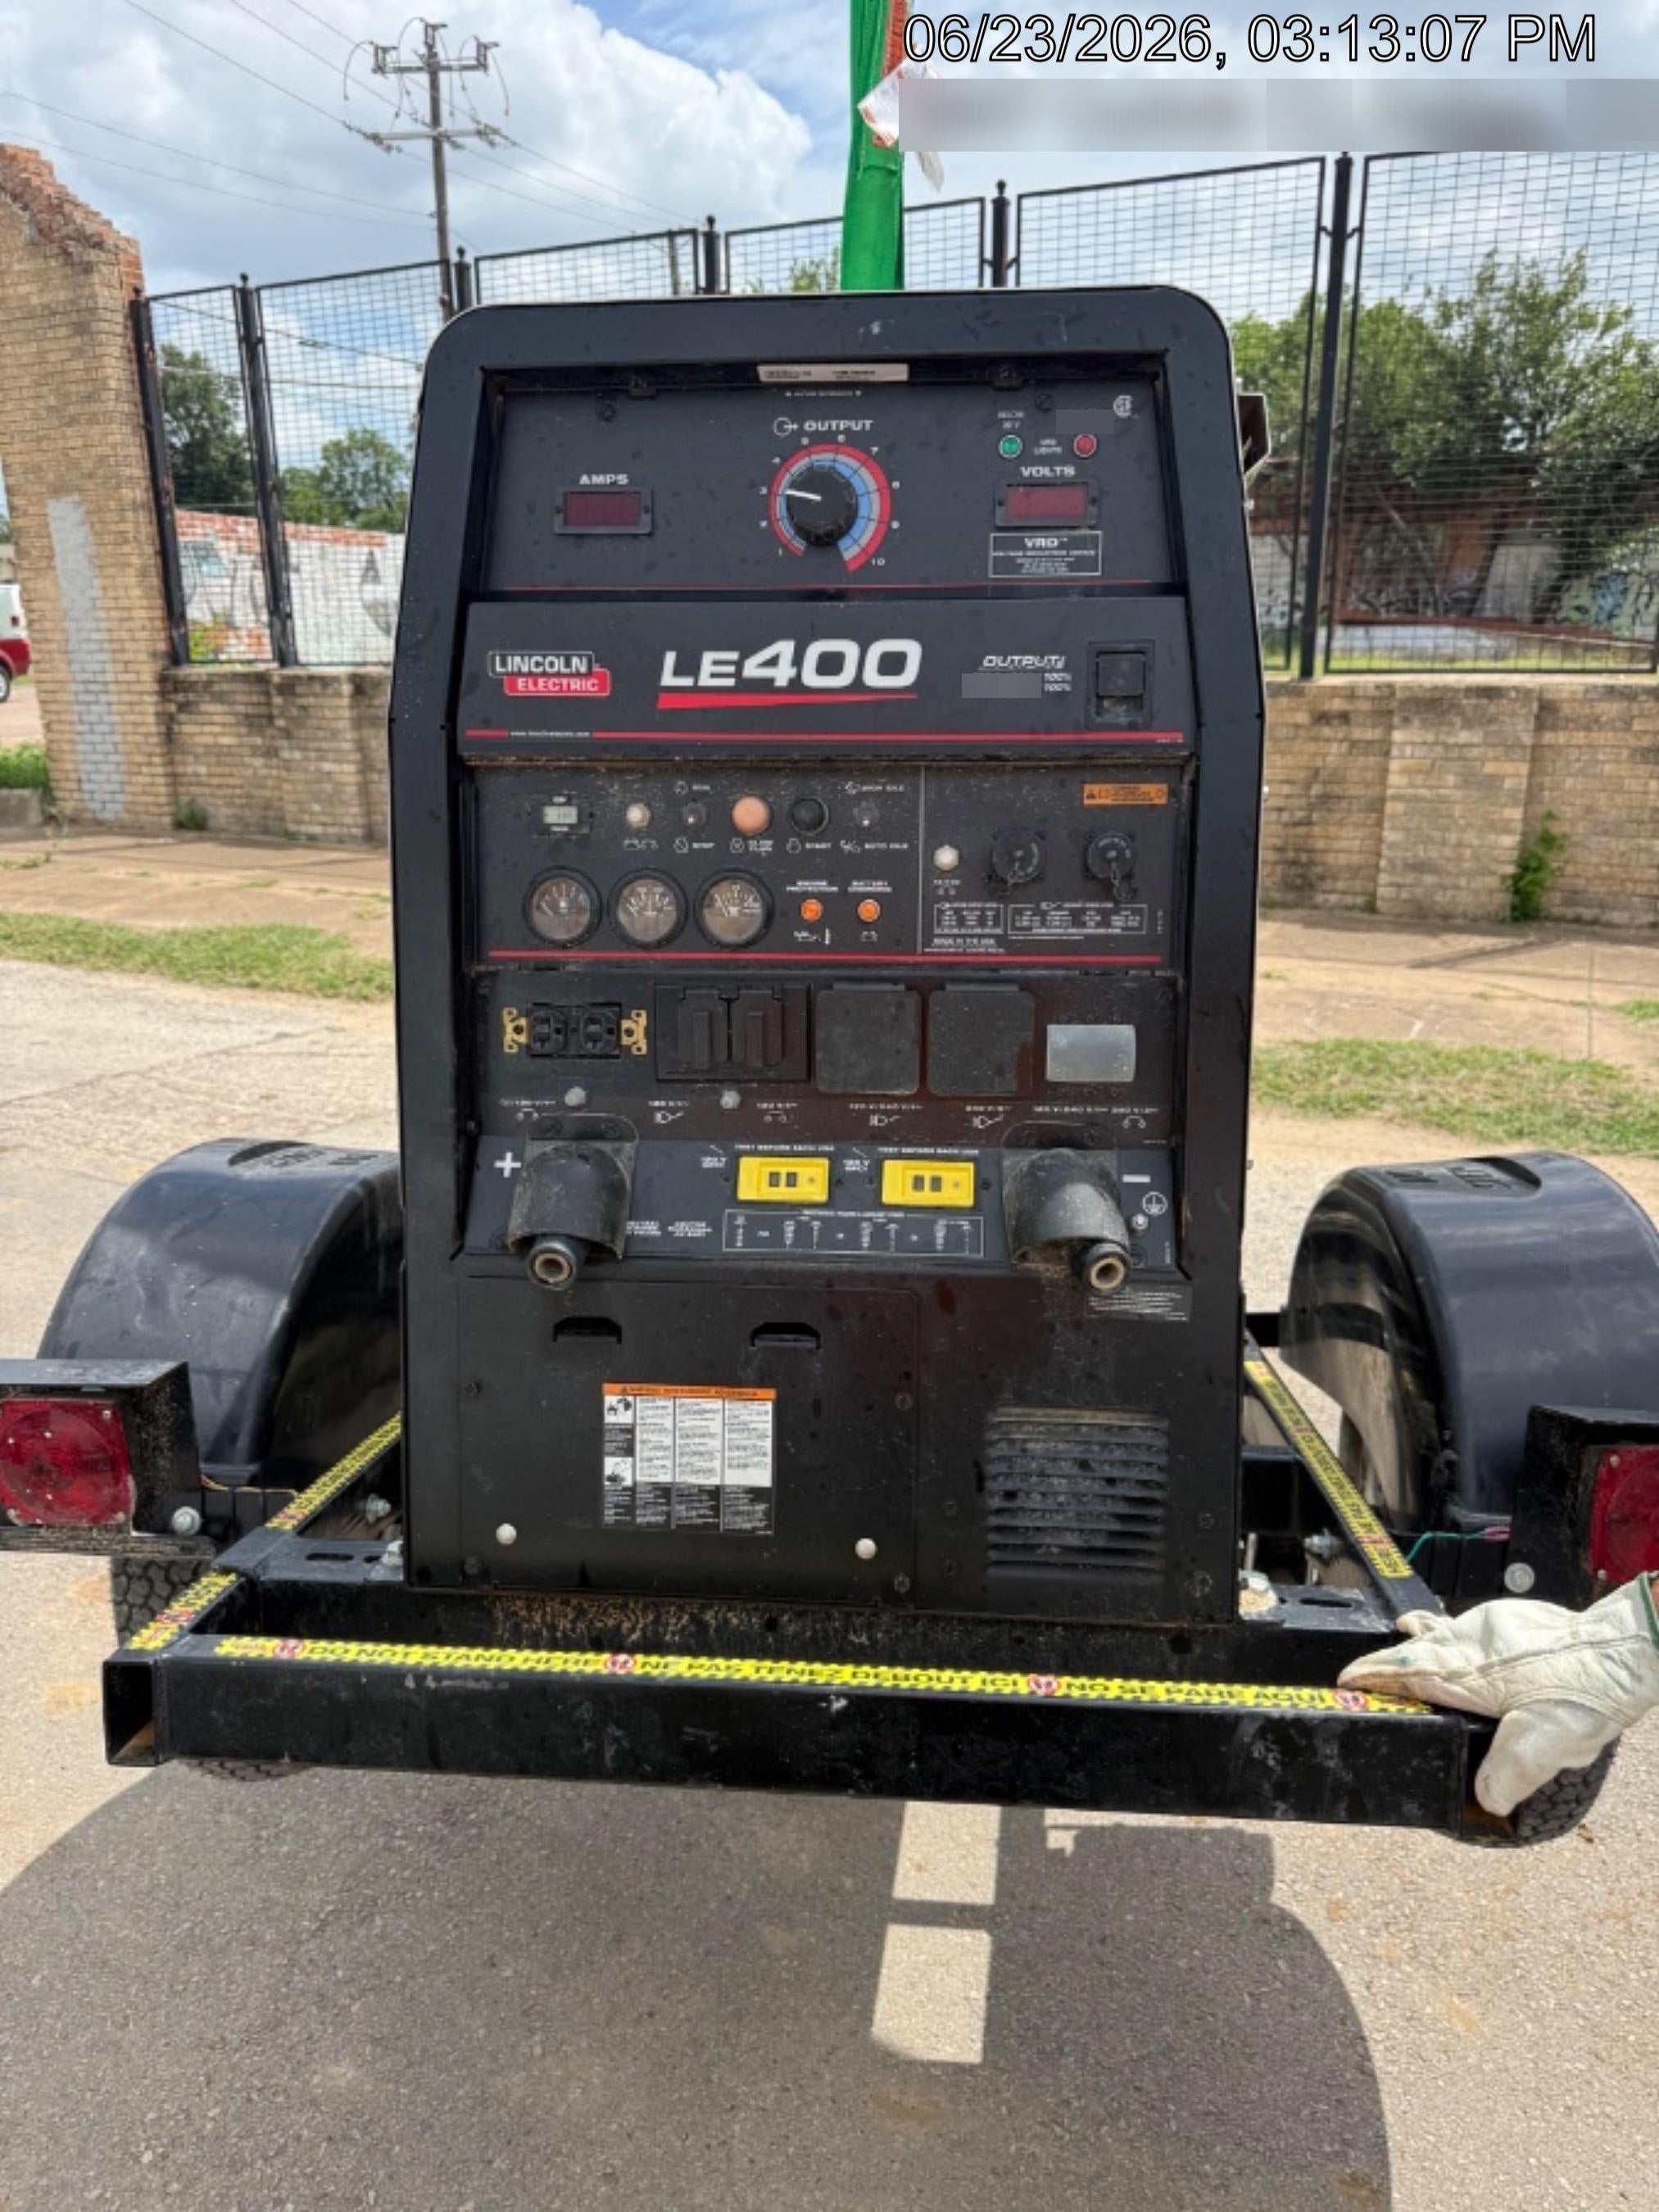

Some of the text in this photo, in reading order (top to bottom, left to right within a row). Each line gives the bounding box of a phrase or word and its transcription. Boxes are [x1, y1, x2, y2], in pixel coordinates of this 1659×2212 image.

[804, 419, 873, 432] OUTPUT
[1019, 465, 1076, 478] VOLTS
[578, 474, 629, 485] AMPS
[494, 654, 587, 674] LINCOLN
[660, 638, 922, 690] LE400
[517, 678, 599, 692] ELECTRIC
[308, 1646, 350, 1656] DO
[356, 1648, 411, 1660] NOT
[981, 1676, 1018, 1688] ICI
[1066, 1681, 1109, 1692] NO
